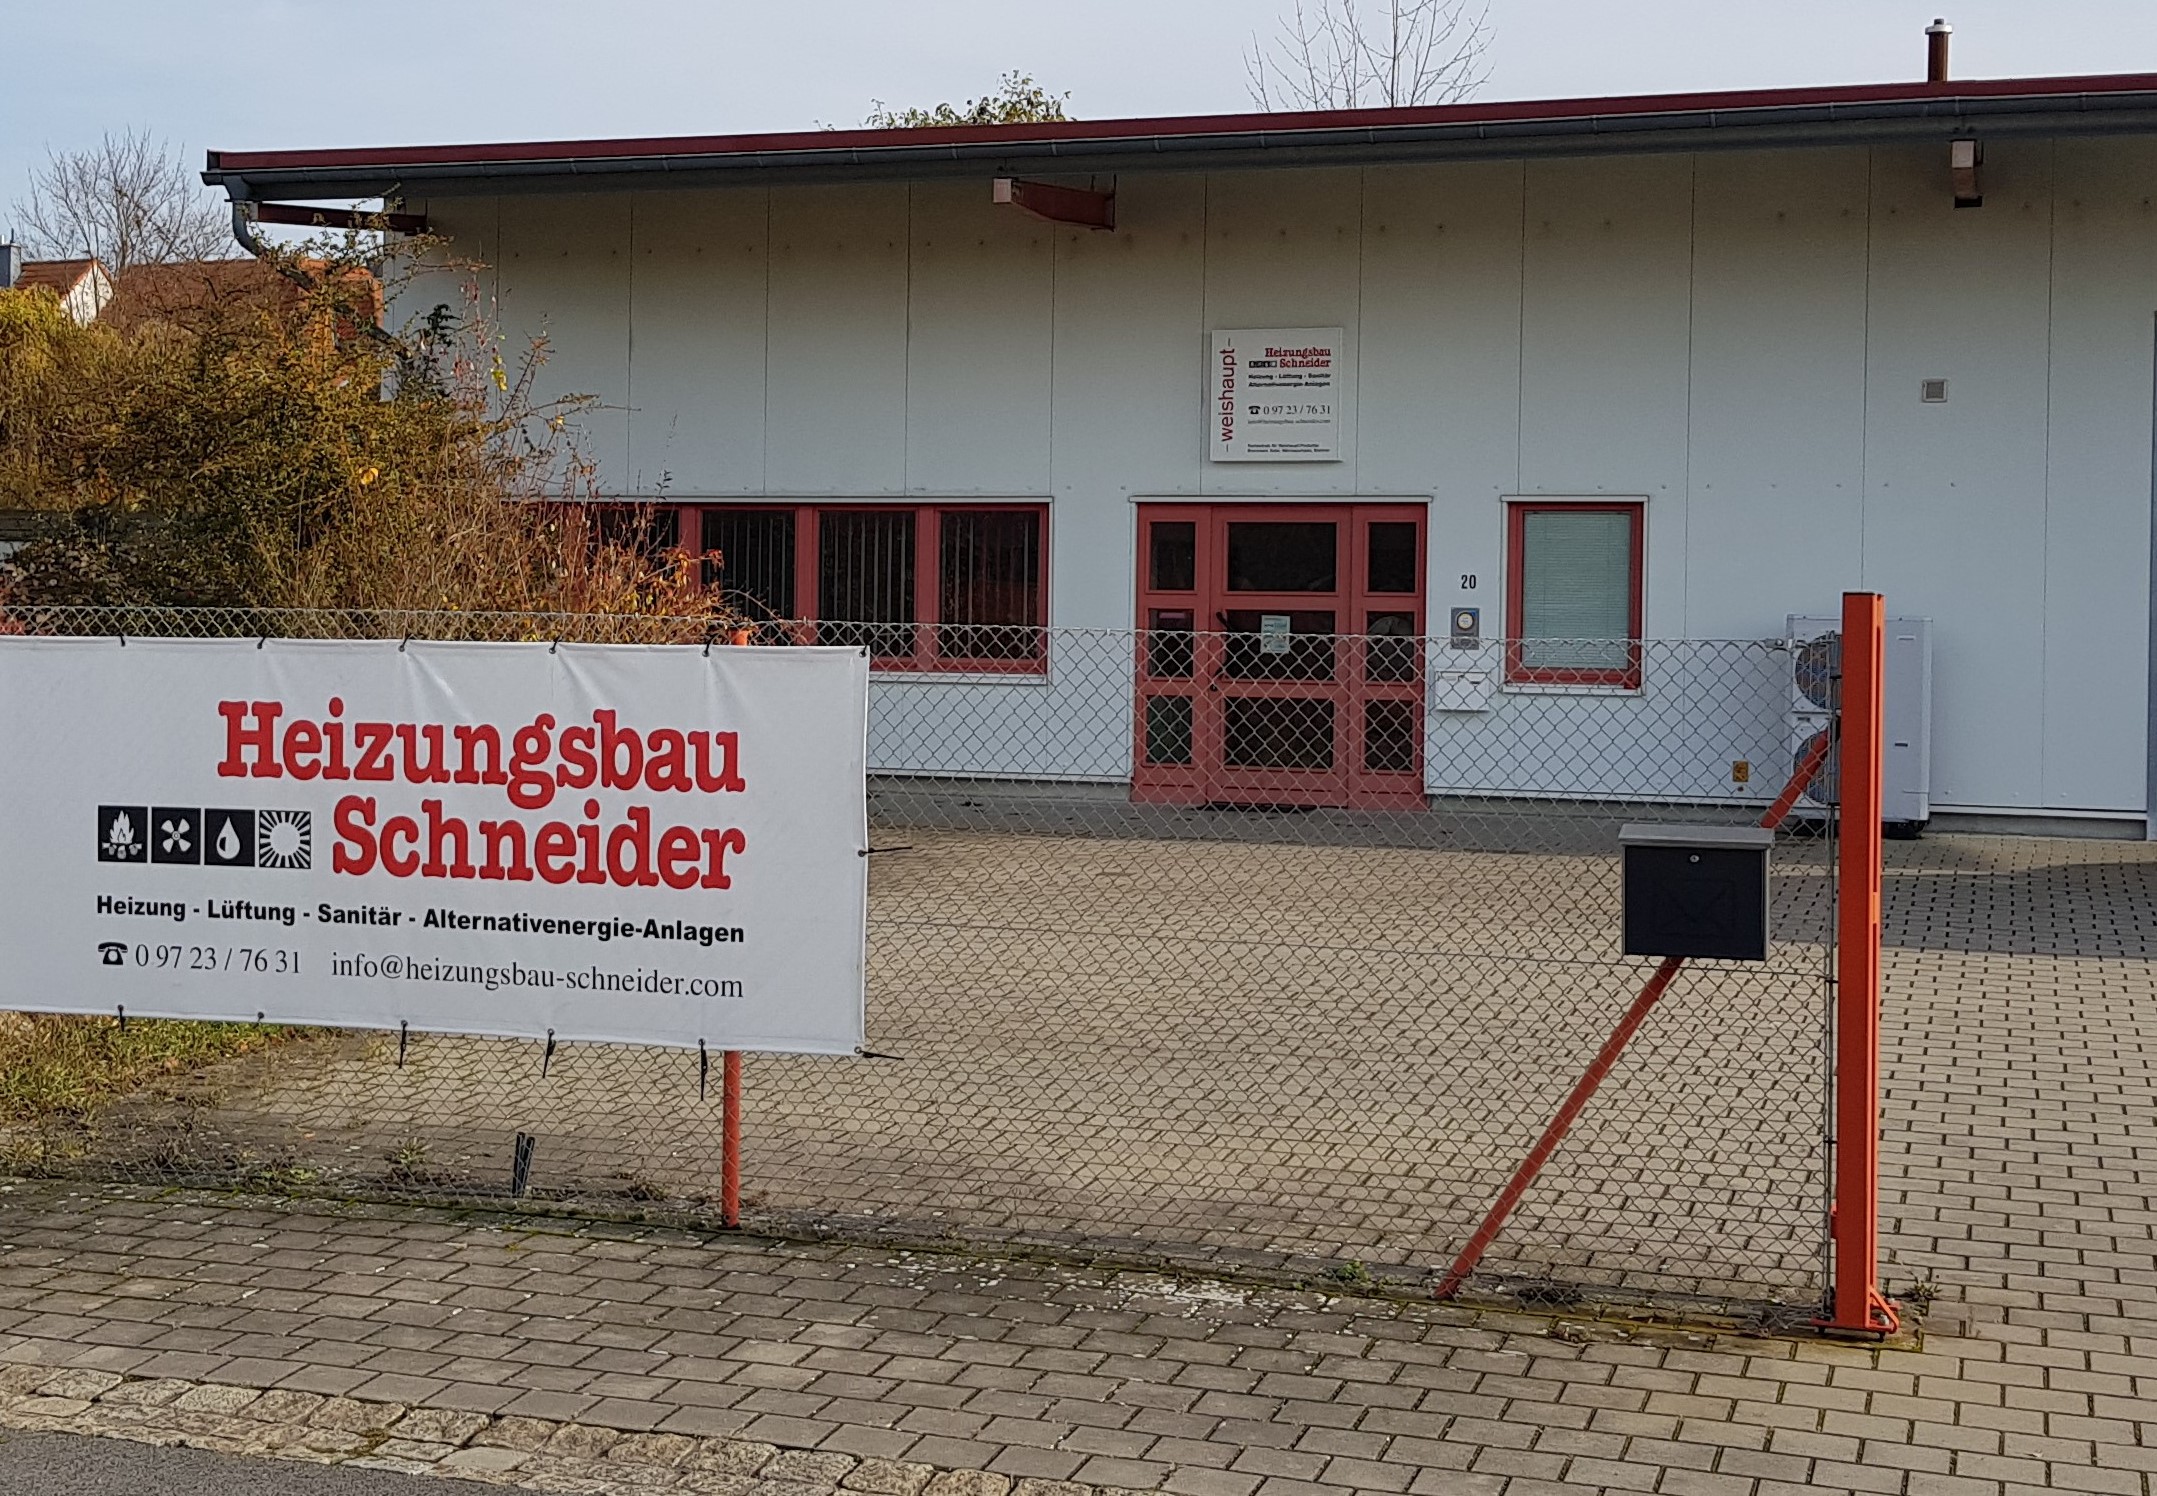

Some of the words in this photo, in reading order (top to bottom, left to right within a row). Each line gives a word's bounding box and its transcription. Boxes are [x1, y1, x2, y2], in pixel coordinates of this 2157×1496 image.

[1264, 346, 1331, 359] Heizungsbau
[1279, 358, 1331, 368] Schneider
[1263, 406, 1270, 415] 0
[1272, 405, 1283, 415] 97
[1286, 405, 1297, 415] 23
[1306, 405, 1318, 415] 76
[1319, 405, 1330, 415] 31
[1461, 574, 1477, 589] 20
[217, 697, 746, 810] Heizungsbau
[332, 795, 746, 890] Schneider
[97, 895, 186, 922] Heizung
[207, 899, 296, 926] Lüftung
[317, 903, 402, 926] Sanitär
[423, 908, 744, 946] Alternativenergie-Anlagen
[135, 943, 149, 967] 0
[156, 944, 182, 969] 97
[189, 946, 217, 971] 23
[224, 947, 233, 971] /
[239, 948, 268, 973] 76
[275, 949, 300, 974] 31
[332, 952, 744, 998] info@heizungsbau-schneider.com
